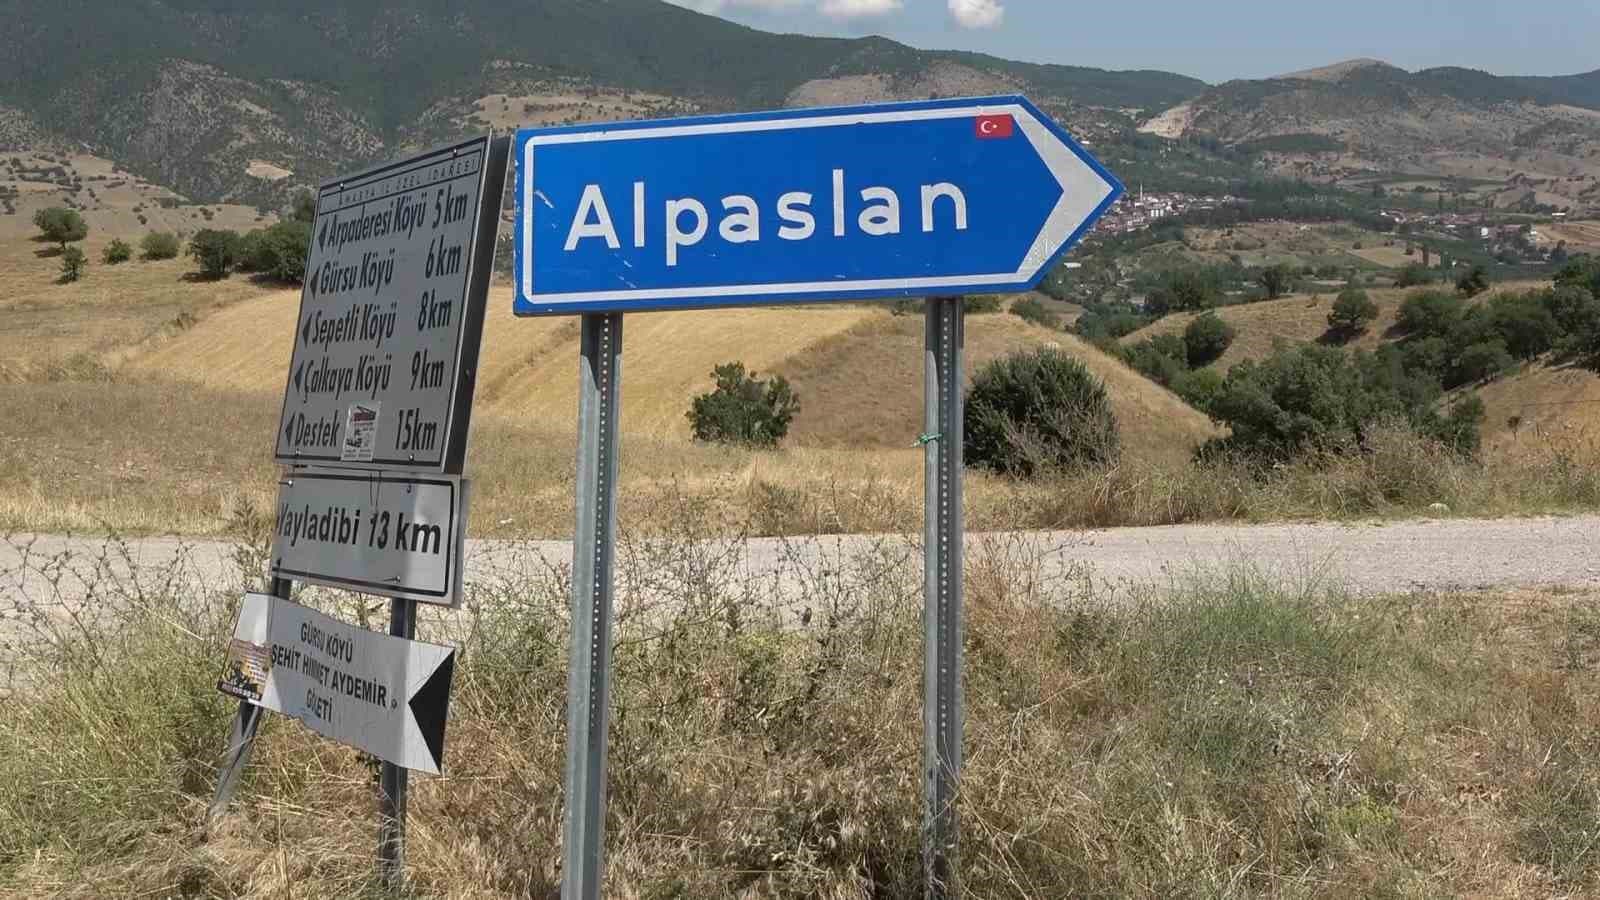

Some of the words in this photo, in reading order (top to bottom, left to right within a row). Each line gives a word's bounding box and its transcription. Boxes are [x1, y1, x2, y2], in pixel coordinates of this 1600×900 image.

[326, 201, 394, 254] Arpaderesi
[393, 191, 428, 240] Köyü
[564, 169, 967, 266] Alpaslan
[320, 260, 358, 293] Gürsu
[359, 248, 395, 296] Köyü
[312, 304, 360, 352] Sepetli
[360, 302, 398, 349] Köyü
[304, 355, 353, 404] Çalkaya
[355, 353, 392, 400] Köyü
[294, 410, 340, 447] Destek
[276, 503, 360, 547] Yayladibi
[369, 511, 390, 550] 13
[395, 512, 442, 555] km
[326, 633, 353, 663] KÖYÜ
[331, 670, 387, 708] AYDEMİR
